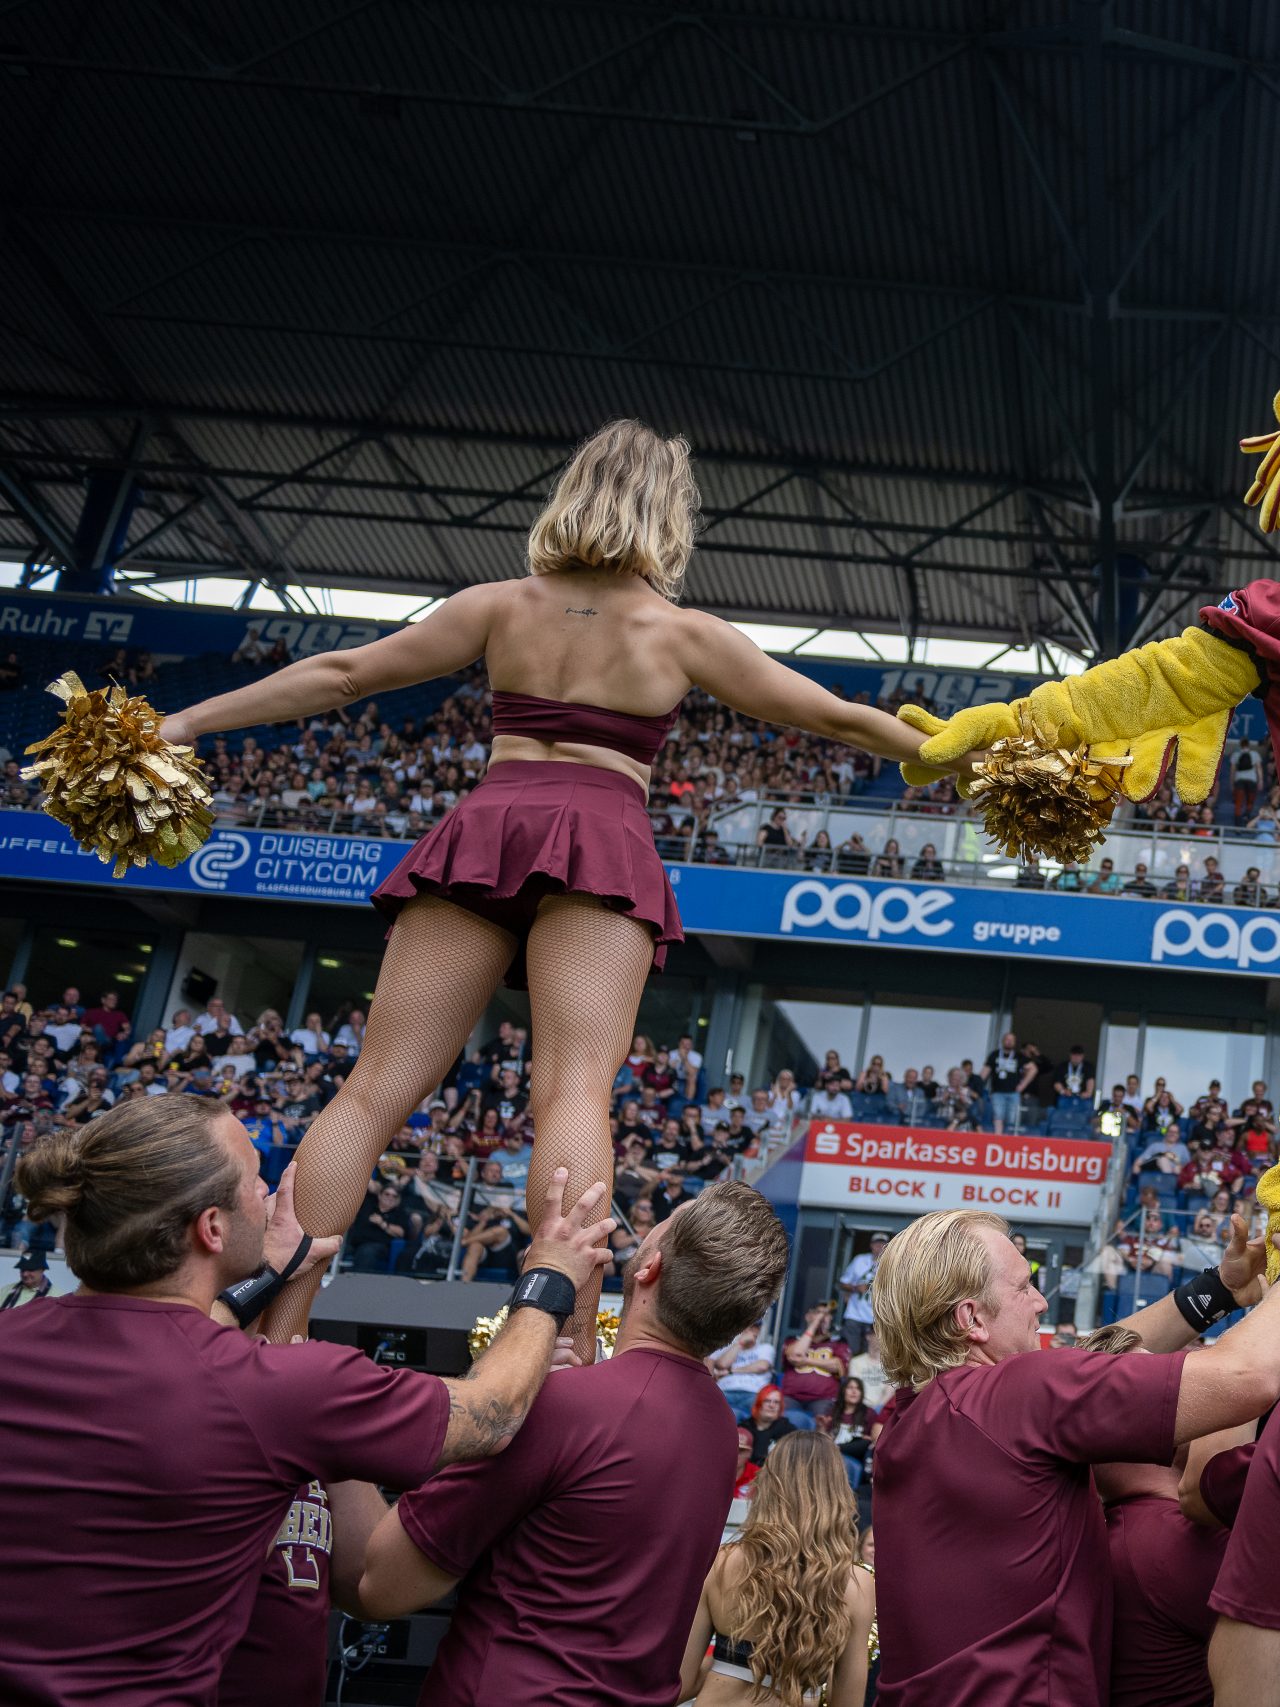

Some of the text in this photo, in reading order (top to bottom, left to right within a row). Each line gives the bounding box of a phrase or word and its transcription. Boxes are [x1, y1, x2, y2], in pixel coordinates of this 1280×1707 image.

[0, 606, 78, 636] Ruhr
[259, 835, 382, 863] DUISBURG
[255, 857, 378, 887] CITY.COM
[780, 880, 1060, 946] pape gruppe
[845, 1133, 1103, 1181] Sparkasse Duisburg
[849, 1177, 1061, 1208] BLOCK I BLOCK II
